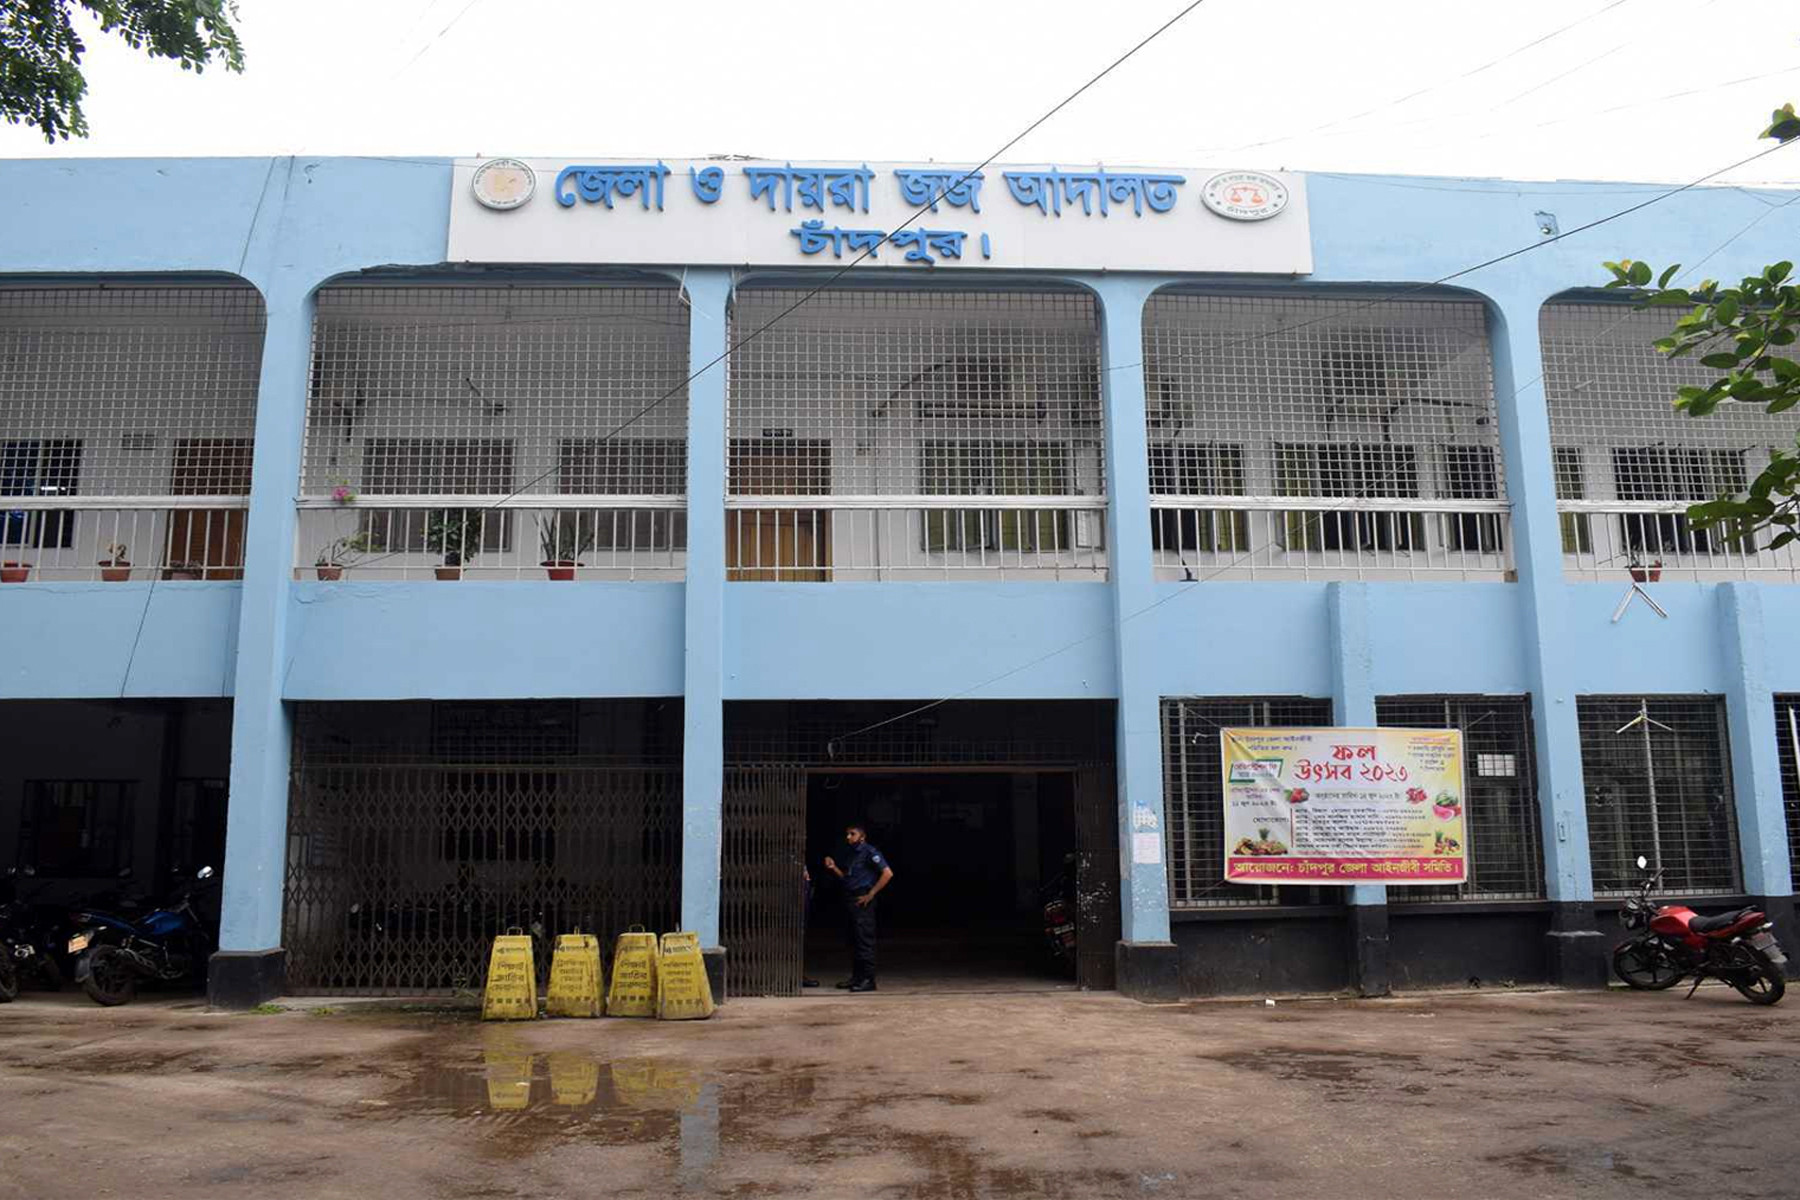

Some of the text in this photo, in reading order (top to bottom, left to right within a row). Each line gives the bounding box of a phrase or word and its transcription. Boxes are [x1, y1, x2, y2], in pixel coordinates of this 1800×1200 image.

[555, 161, 671, 210] জেলা
[690, 166, 724, 203] ও
[743, 162, 876, 213] দায়রা
[894, 169, 985, 213] জজ
[1002, 166, 1186, 217] আদালত
[1330, 745, 1376, 760] ফল
[1294, 759, 1408, 782] উৎসব ২০২৩
[1299, 860, 1335, 876] চাঁদপুর
[1340, 863, 1367, 874] জেলা
[1371, 859, 1420, 874] আইনজীবী
